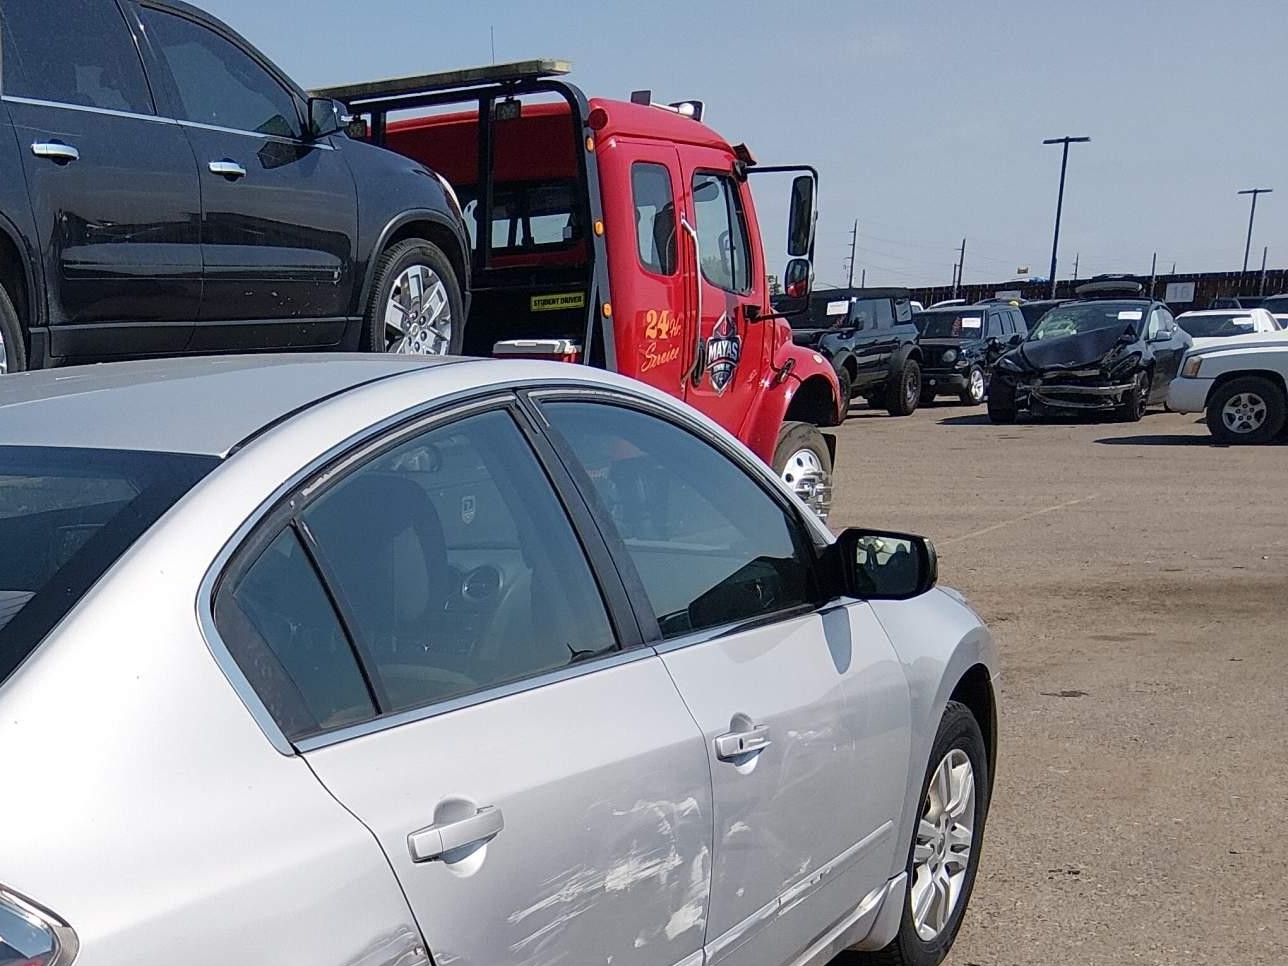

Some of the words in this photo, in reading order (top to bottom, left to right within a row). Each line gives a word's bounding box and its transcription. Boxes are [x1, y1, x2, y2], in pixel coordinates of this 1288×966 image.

[533, 297, 560, 307] STUDENT
[645, 309, 670, 340] 24
[640, 342, 680, 372] Service
[708, 340, 738, 365] MAYAS
